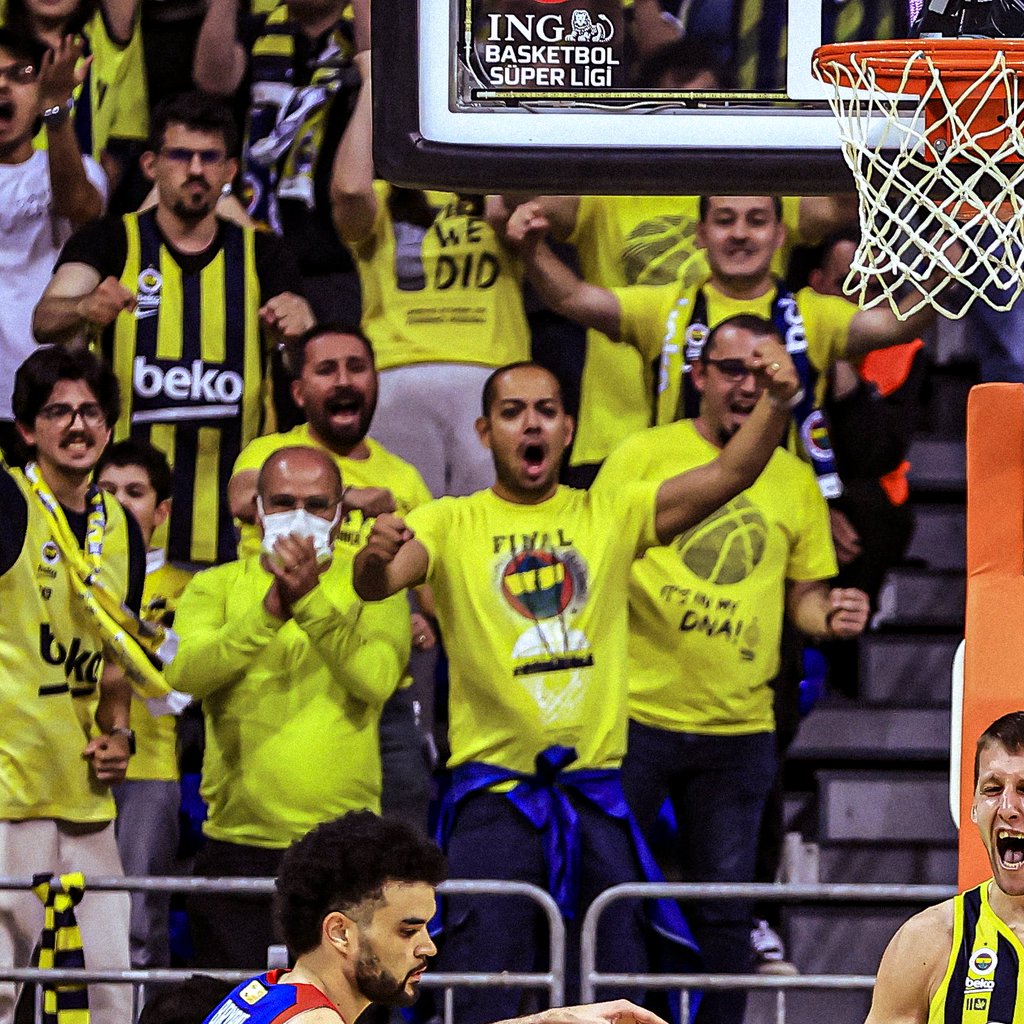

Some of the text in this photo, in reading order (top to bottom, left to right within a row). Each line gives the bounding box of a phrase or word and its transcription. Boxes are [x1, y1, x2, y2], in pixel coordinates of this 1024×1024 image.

[487, 14, 565, 42] ING
[485, 45, 620, 65] BASKETBOL
[490, 65, 612, 87] SÜPER LİGİ
[435, 252, 500, 289] DID
[134, 356, 243, 403] beko
[965, 976, 995, 987] beko
